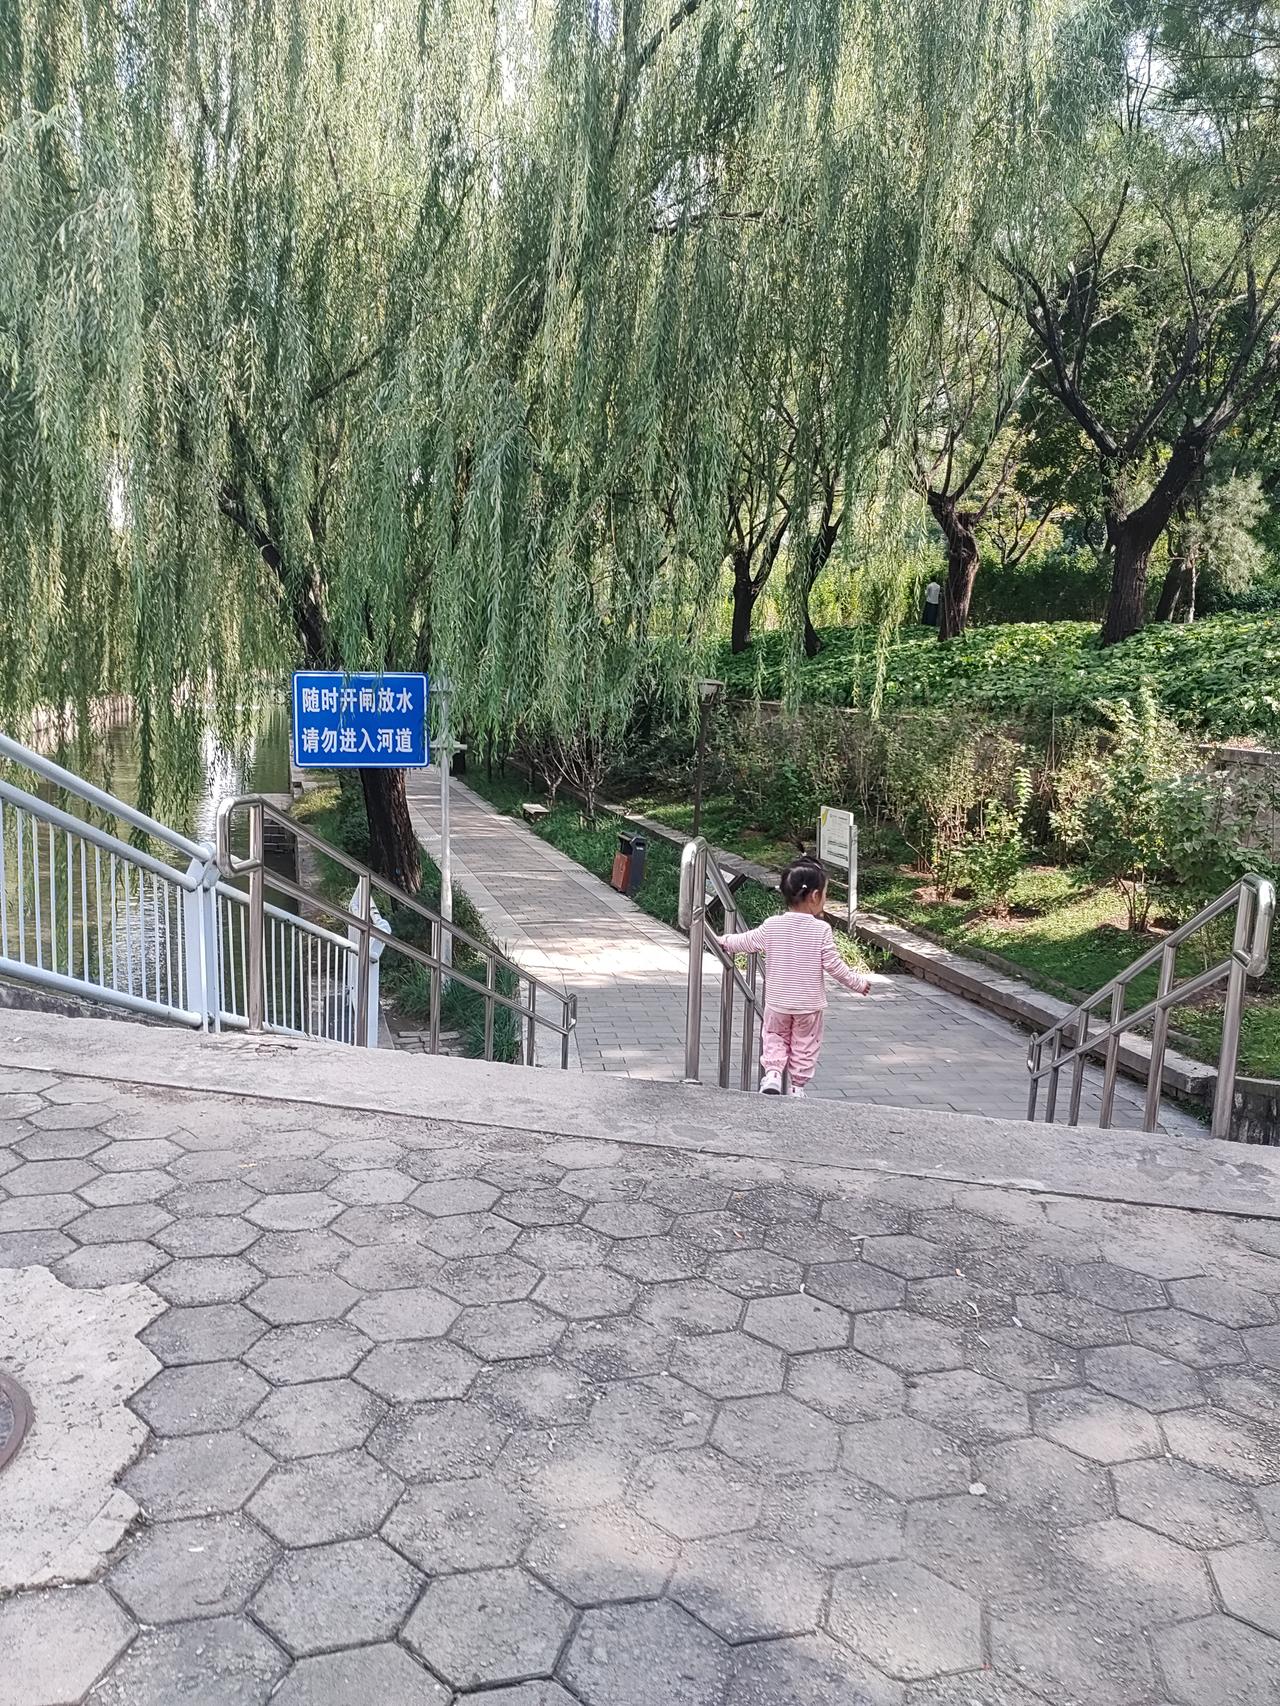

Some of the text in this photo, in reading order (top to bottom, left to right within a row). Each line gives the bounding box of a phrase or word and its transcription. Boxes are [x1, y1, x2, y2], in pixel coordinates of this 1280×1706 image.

[302, 687, 413, 713] 随时开闸放水
[302, 727, 413, 753] 请勿进入河道
